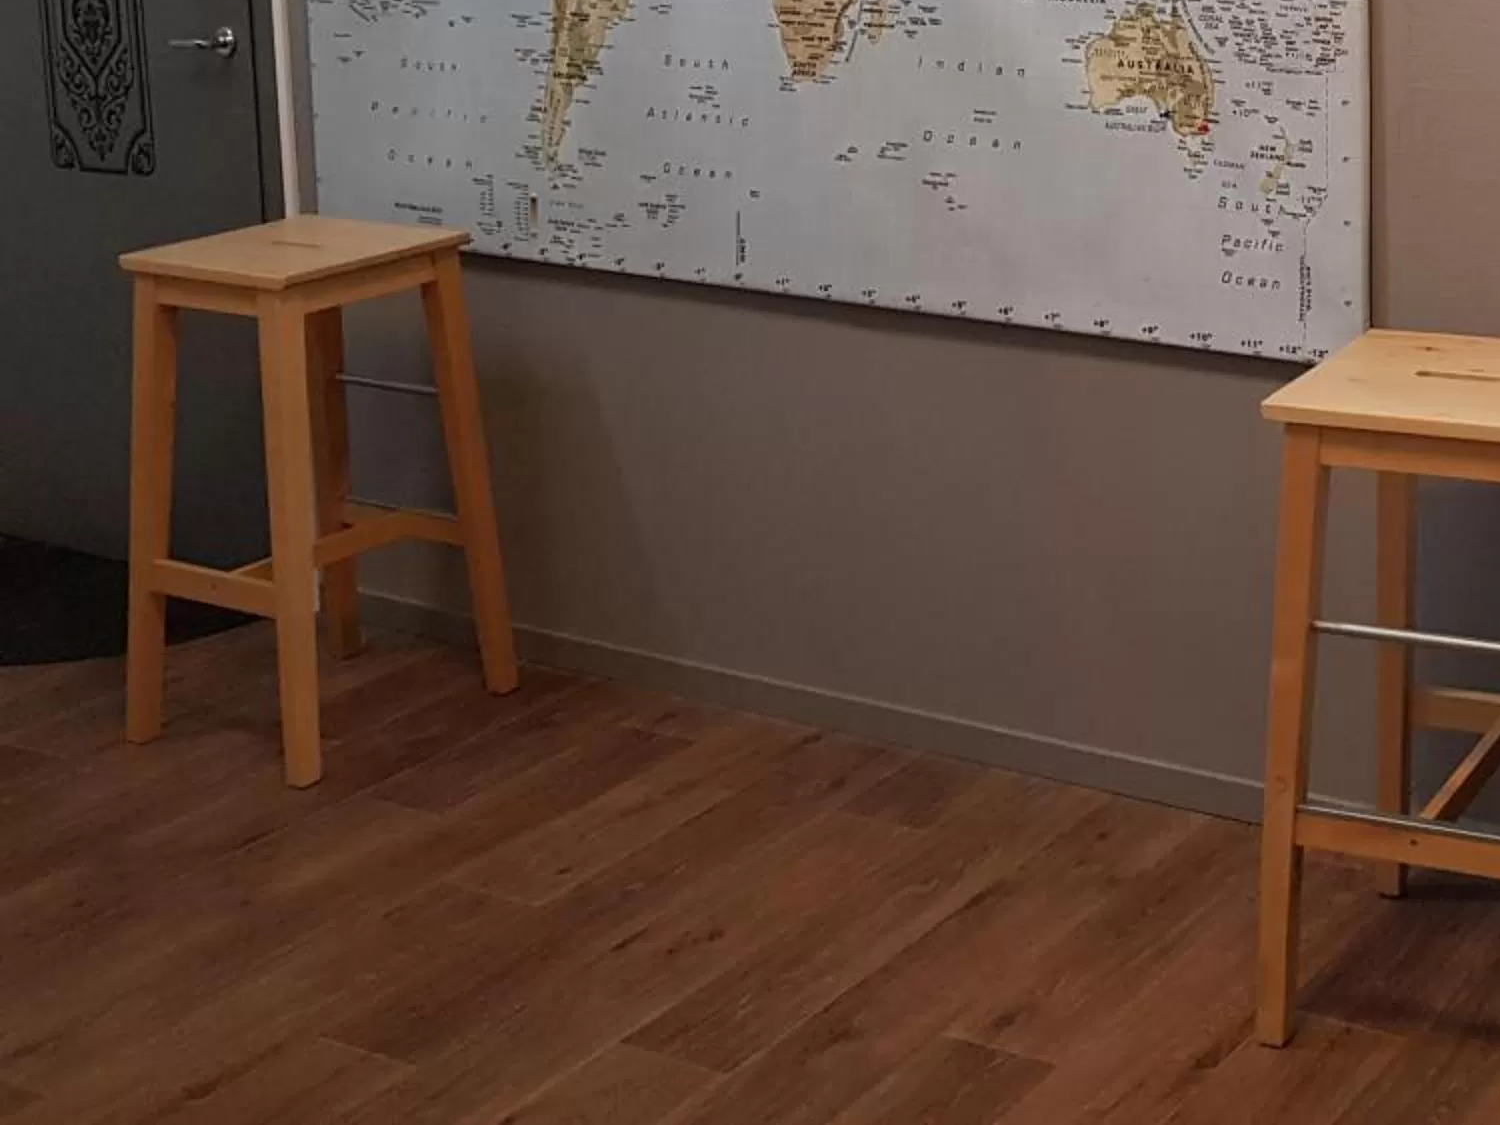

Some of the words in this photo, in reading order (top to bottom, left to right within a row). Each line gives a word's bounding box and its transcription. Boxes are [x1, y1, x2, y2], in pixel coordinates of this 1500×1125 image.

[1117, 59, 1195, 74] AUSTRALIA
[1221, 234, 1285, 252] Pacific
[1221, 270, 1280, 290] Ocean
